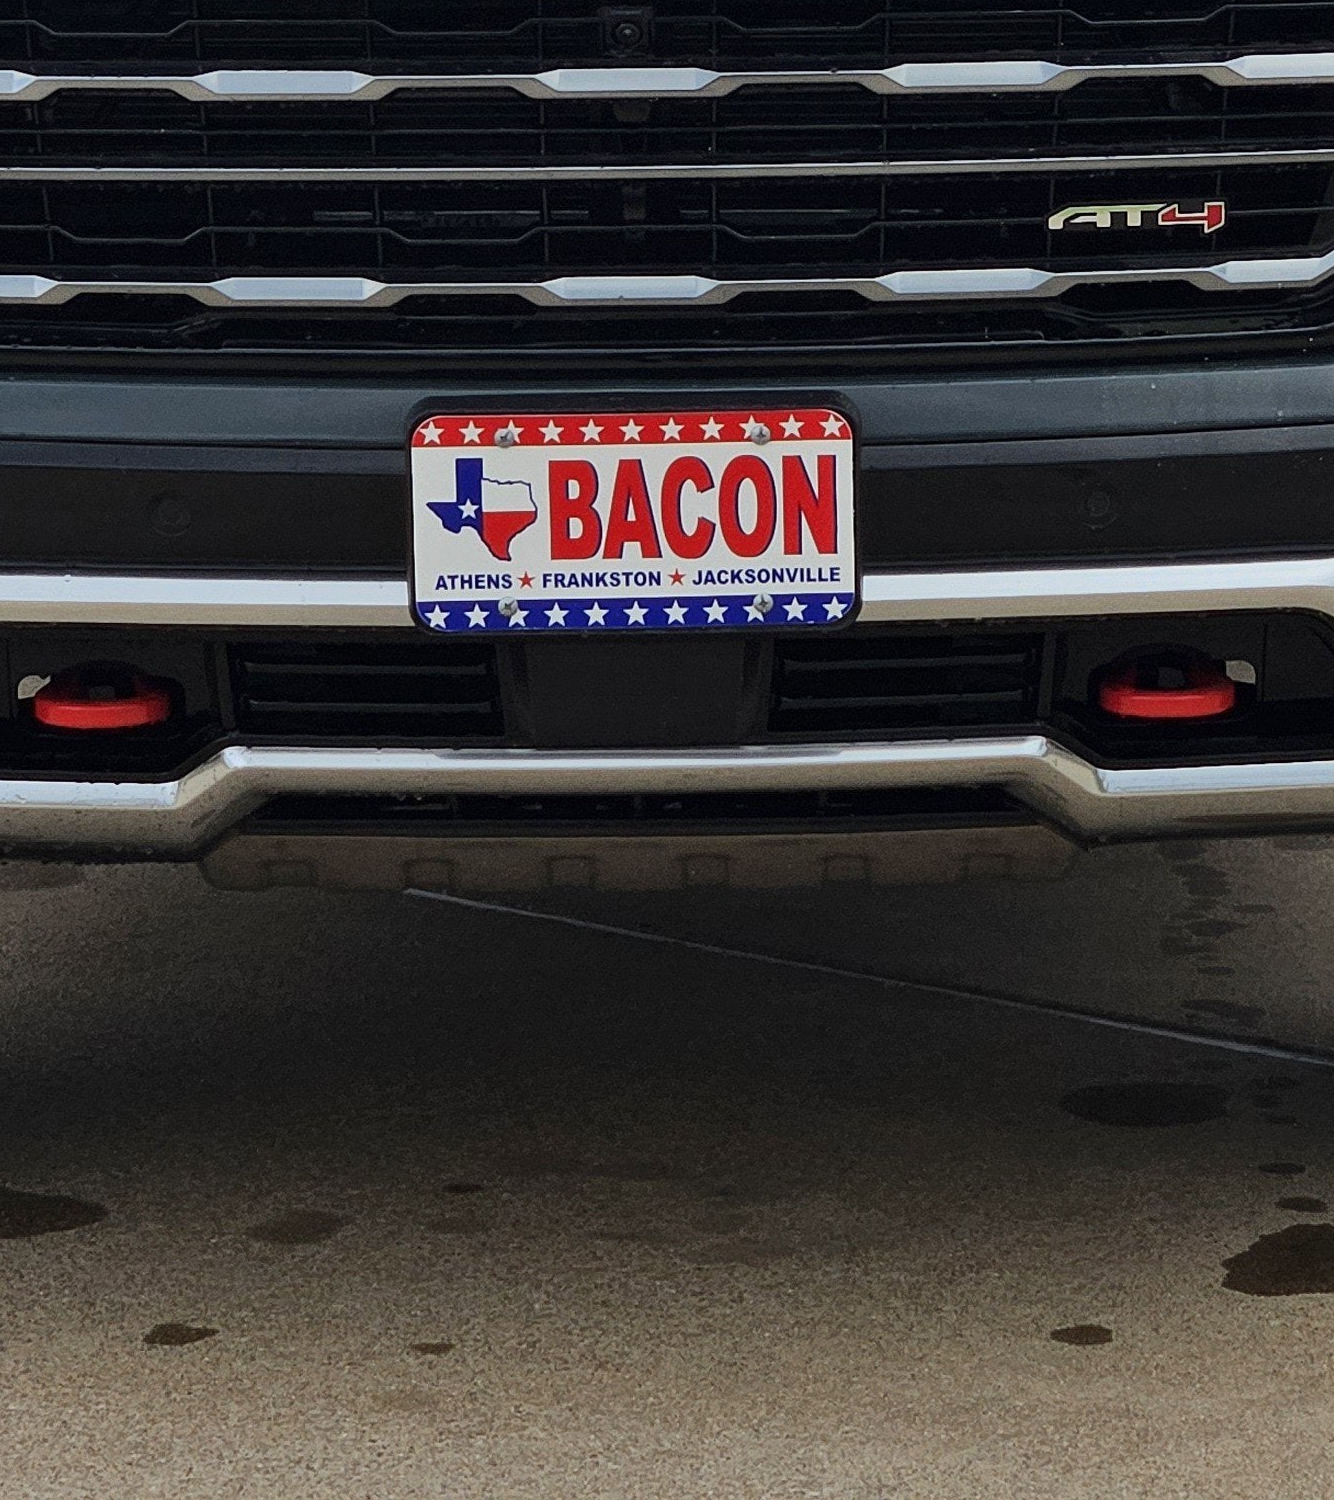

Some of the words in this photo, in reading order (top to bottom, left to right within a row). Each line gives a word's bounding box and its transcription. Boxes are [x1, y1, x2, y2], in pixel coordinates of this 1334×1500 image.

[1048, 201, 1225, 233] AT4
[548, 455, 838, 560] BACON
[435, 573, 513, 591] ATHENS
[542, 570, 661, 589] FRANKSTON
[693, 567, 841, 586] JACKSONVILLE
